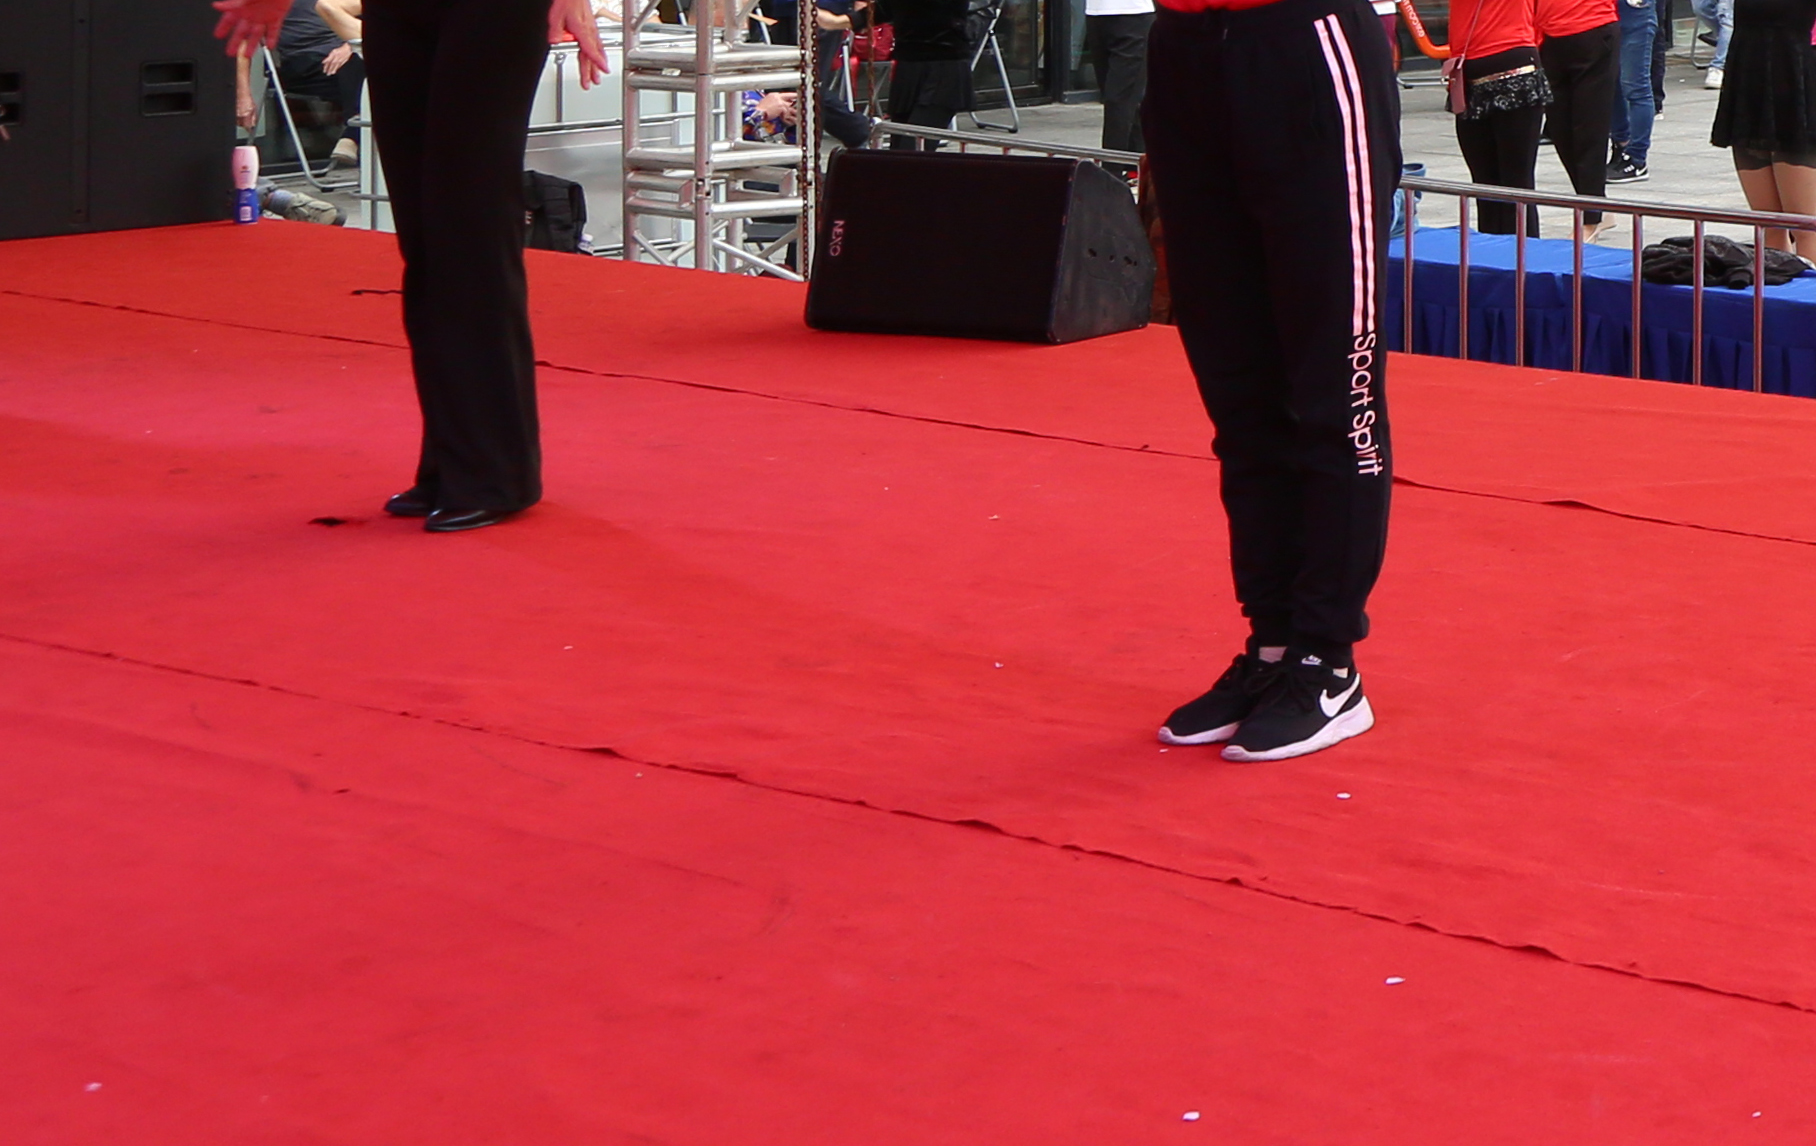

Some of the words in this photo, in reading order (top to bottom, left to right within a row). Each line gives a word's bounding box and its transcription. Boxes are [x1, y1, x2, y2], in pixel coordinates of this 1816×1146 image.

[829, 220, 845, 256] NEXO
[1347, 333, 1376, 408] Sport
[1347, 410, 1383, 476] Spirit
